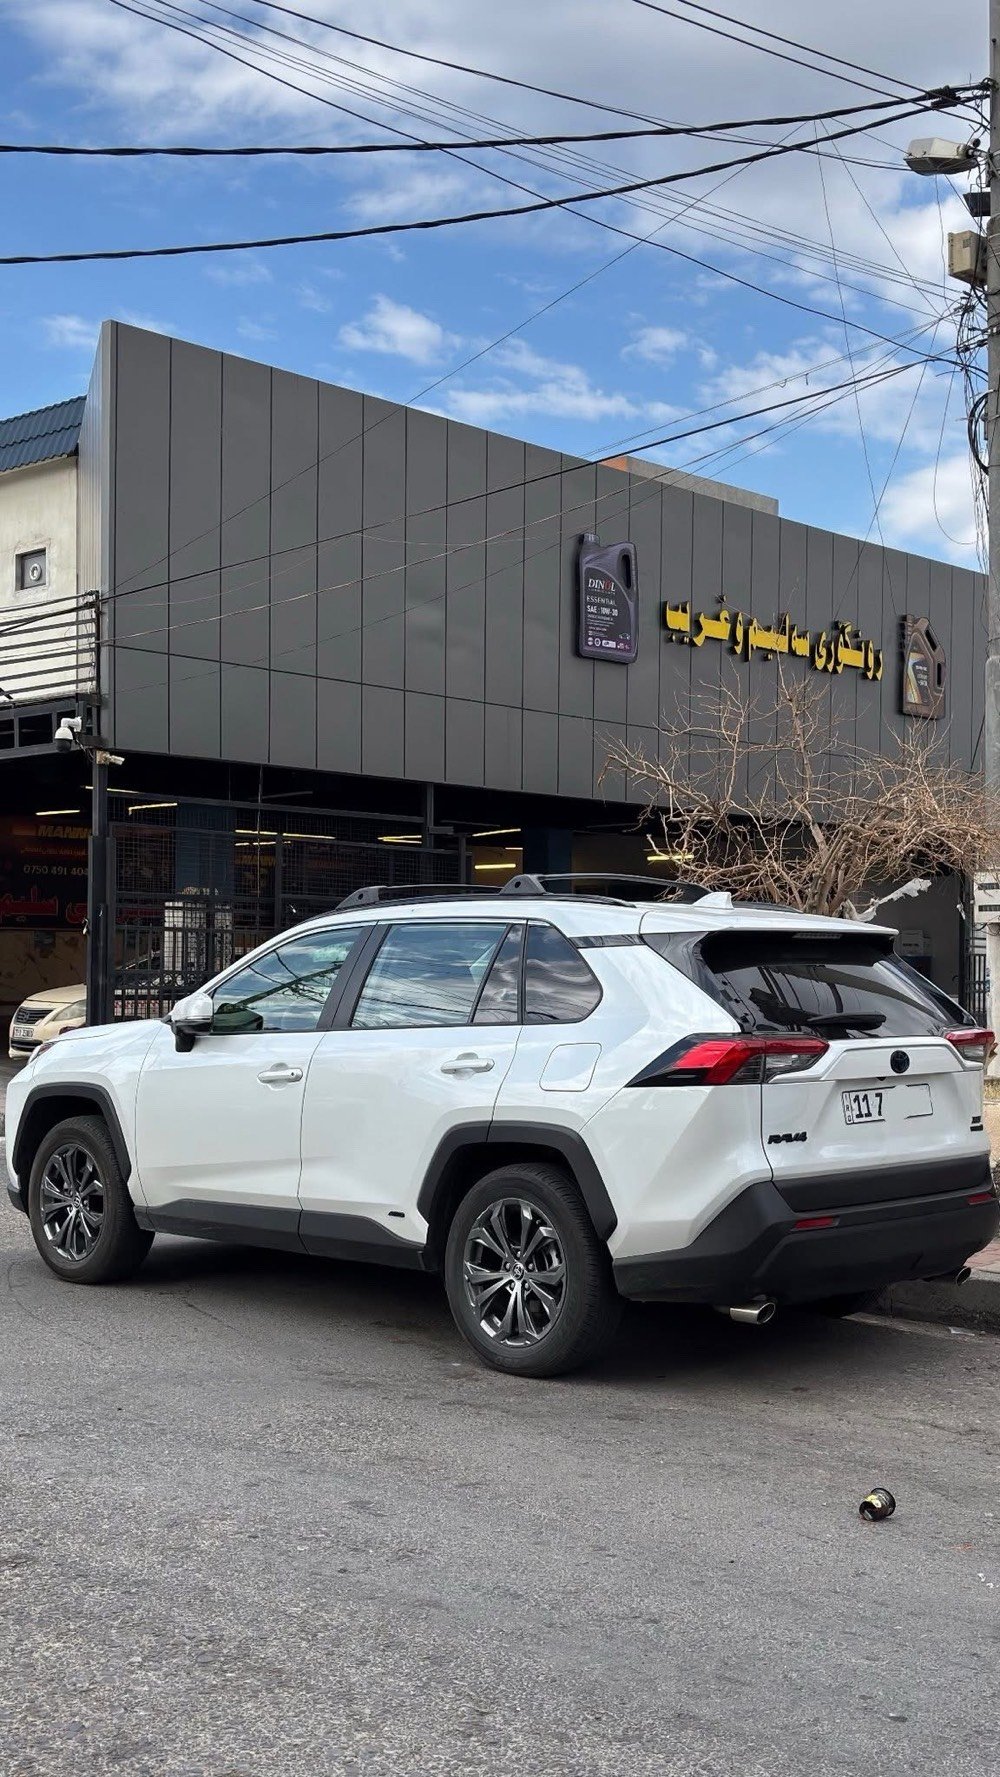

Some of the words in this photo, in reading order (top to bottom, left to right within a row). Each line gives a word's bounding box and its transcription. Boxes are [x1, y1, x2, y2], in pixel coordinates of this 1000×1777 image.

[586, 595, 617, 607] ESSENTIAL
[586, 604, 598, 614] SAE
[23, 864, 48, 875] 0750
[767, 1131, 807, 1144] RAV4
